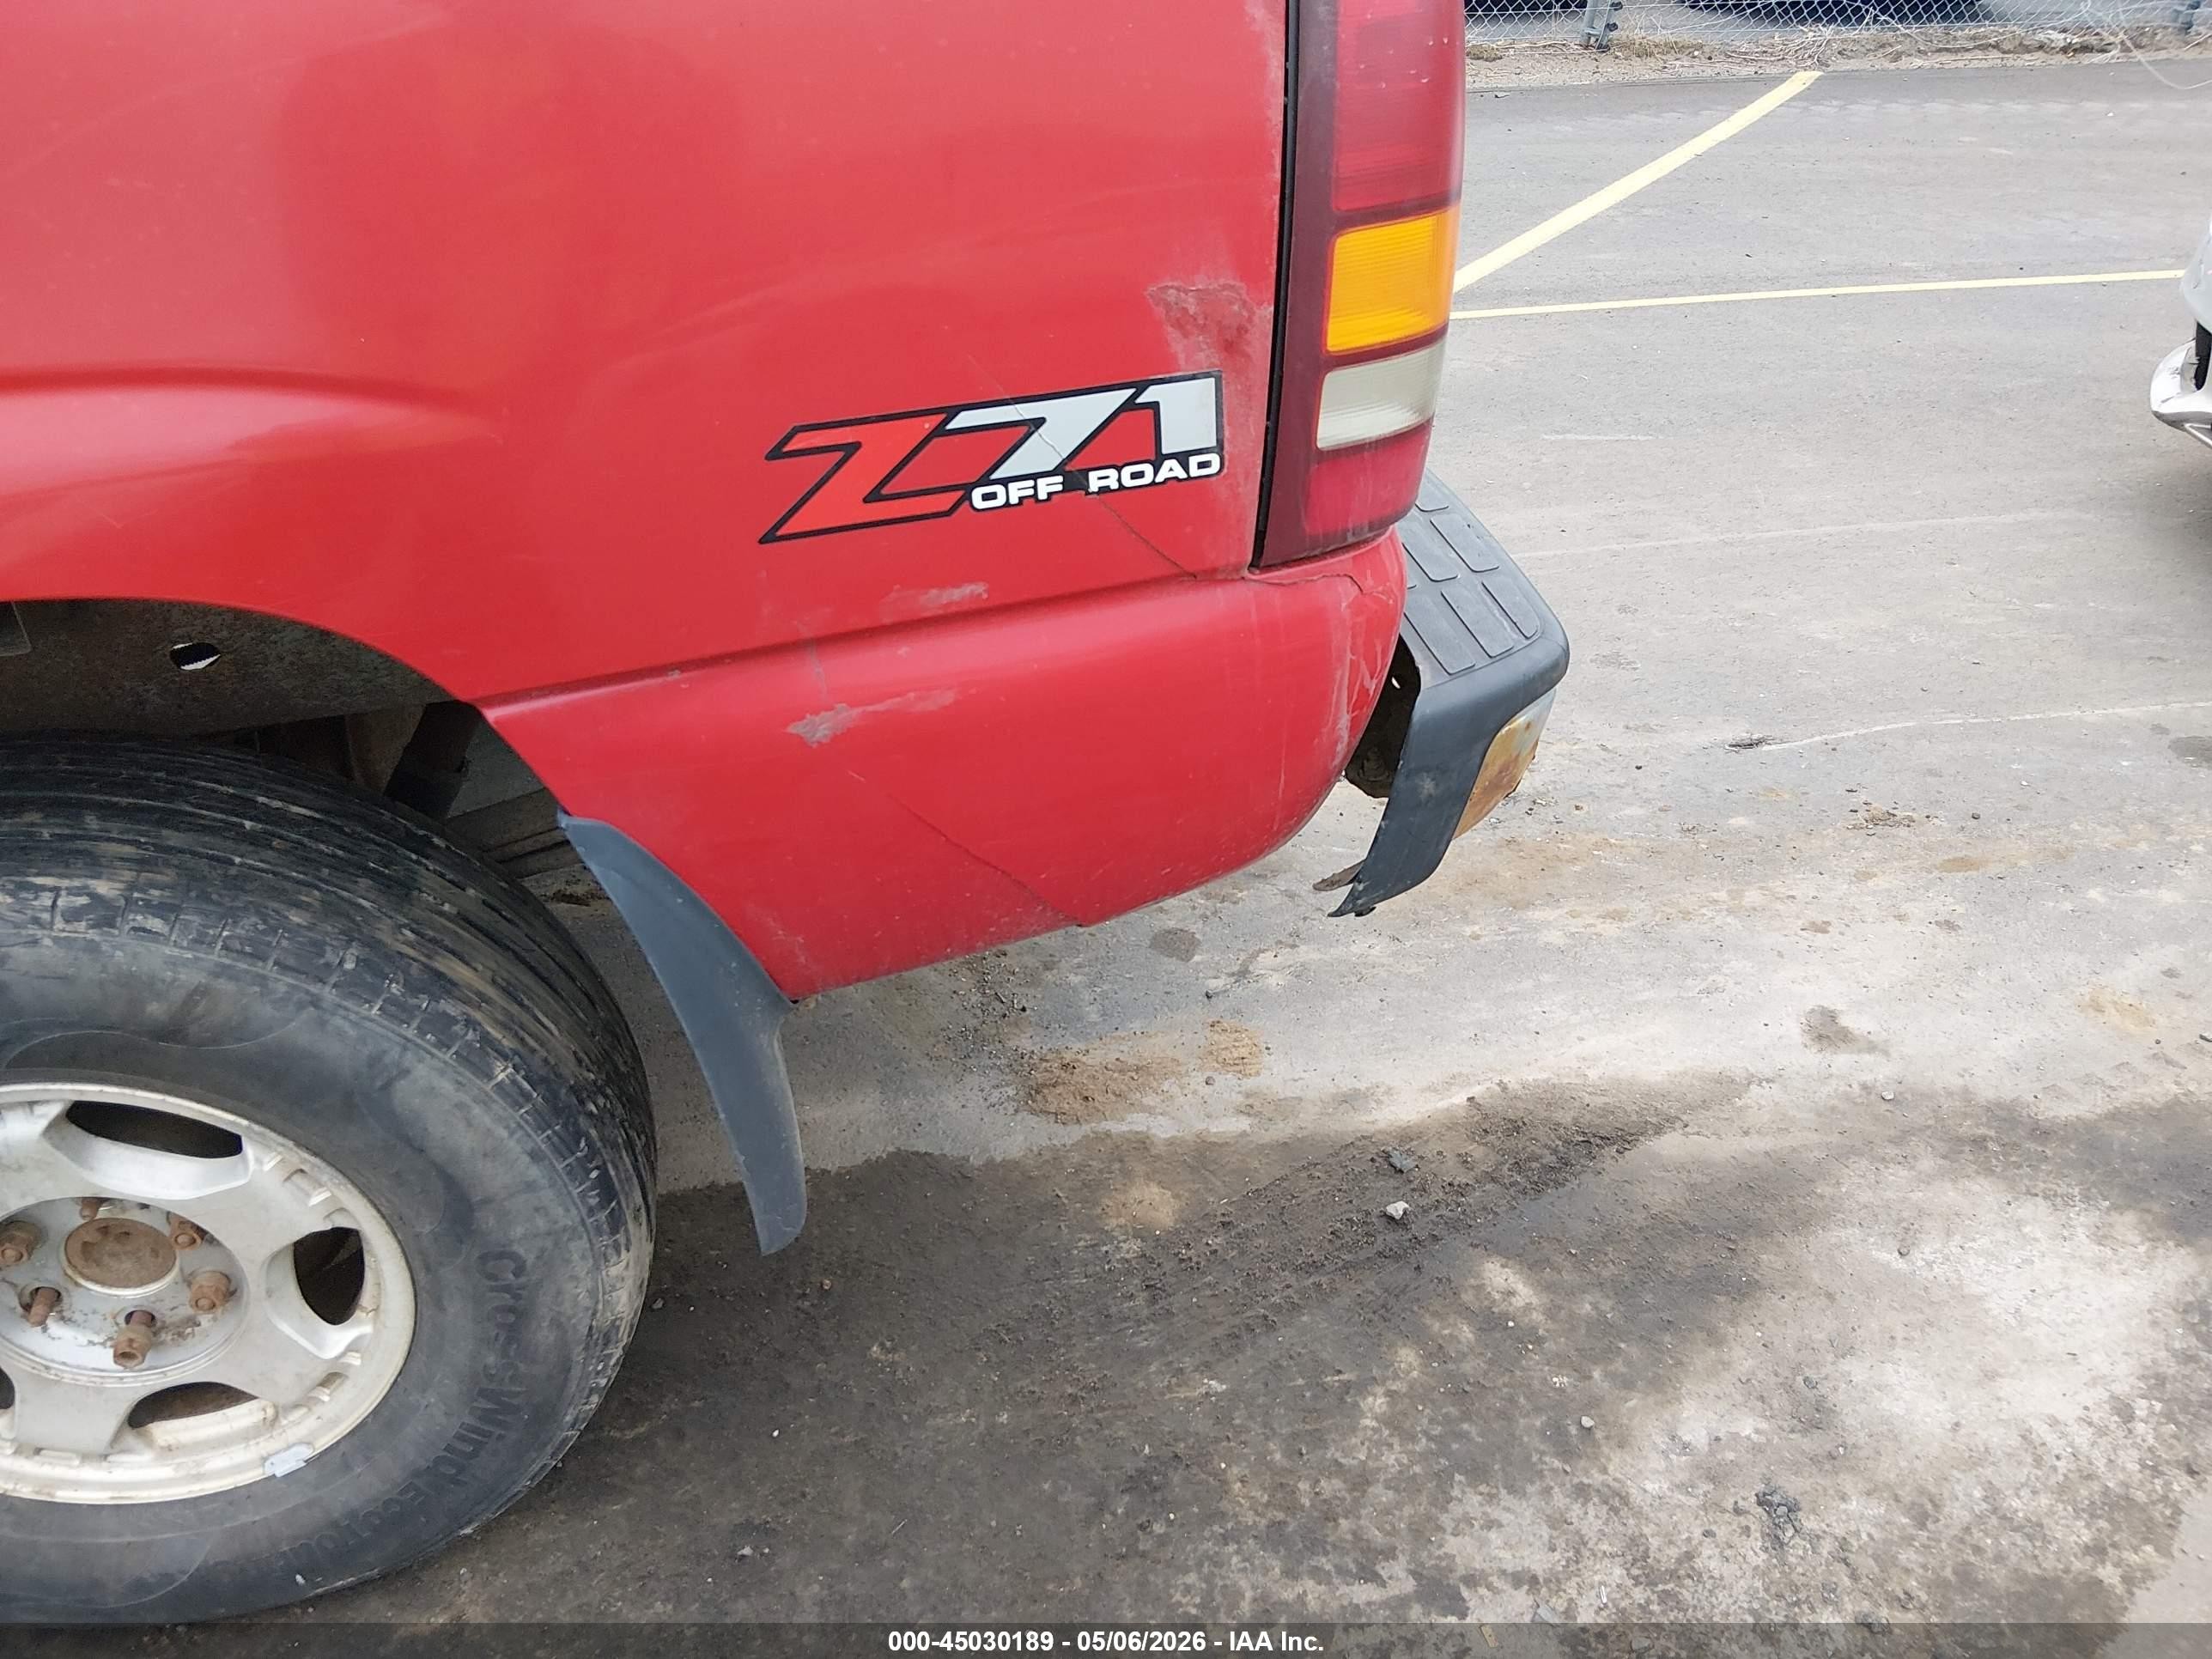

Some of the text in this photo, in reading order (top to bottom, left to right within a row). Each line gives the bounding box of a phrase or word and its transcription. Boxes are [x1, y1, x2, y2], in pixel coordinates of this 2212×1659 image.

[758, 370, 1224, 544] Z71
[971, 452, 1222, 513] OFF ROAD
